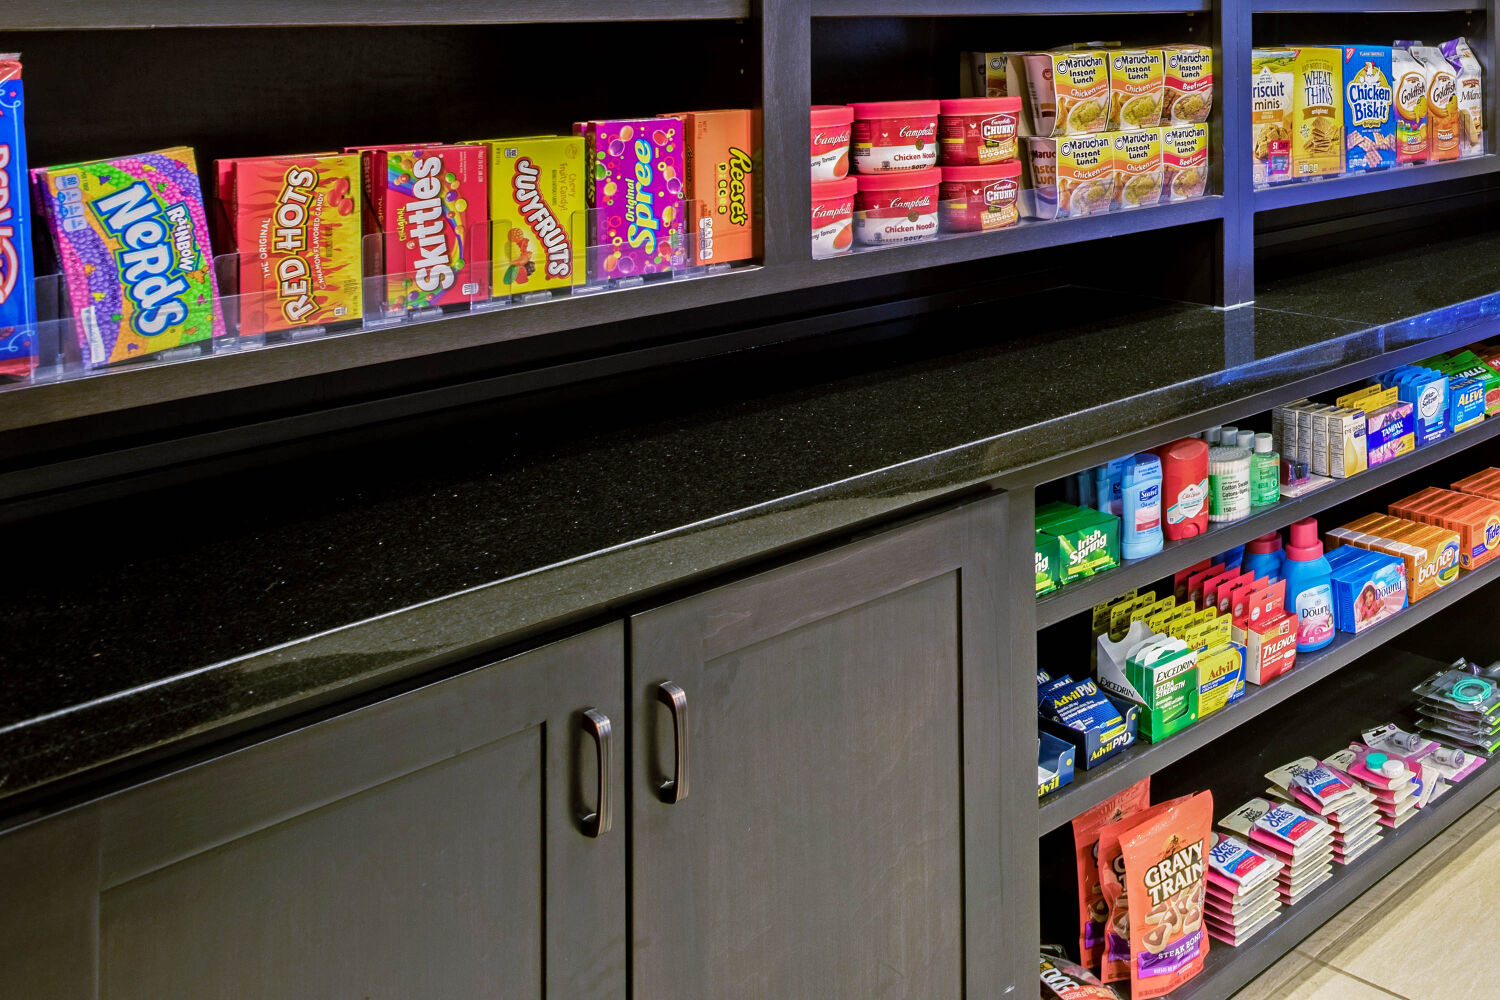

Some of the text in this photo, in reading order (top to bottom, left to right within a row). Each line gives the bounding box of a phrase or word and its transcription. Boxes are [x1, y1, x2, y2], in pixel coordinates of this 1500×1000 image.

[1068, 58, 1103, 69] Maruchan
[1121, 54, 1159, 64] Maruchan
[1176, 54, 1210, 63] Maruchan
[1069, 68, 1096, 77] Instant
[1125, 65, 1151, 73] Instant
[1179, 64, 1203, 72] Instant
[1181, 70, 1200, 78] Lunch
[1073, 76, 1094, 85] Lunch
[1128, 72, 1148, 80] Lunch
[1303, 71, 1333, 87] WHEAT
[1070, 87, 1096, 98] Chicken
[1125, 83, 1151, 92] Chicken
[1182, 81, 1198, 90] Beef
[1252, 84, 1285, 98] riscuit
[1433, 81, 1456, 104] Goldfish
[1349, 85, 1391, 103] Chicken
[1401, 84, 1426, 105] Goldfish
[1254, 99, 1281, 110] minis
[1354, 103, 1387, 121] Biskit
[983, 123, 1015, 135] CHUNKY
[1172, 129, 1205, 139] Maruchan
[1070, 138, 1109, 150] Maruchan
[1123, 133, 1158, 144] Maruchan
[1174, 139, 1197, 147] Instant
[1073, 150, 1101, 159] Instant
[1125, 144, 1150, 153] Instant
[1128, 151, 1148, 159] Lunch
[1177, 146, 1195, 154] Lunch
[1076, 157, 1098, 166] Lunch
[1126, 162, 1150, 171] Chicken
[1179, 158, 1193, 166] Beef
[1073, 168, 1100, 178] Chicken
[729, 147, 753, 226] Reese's
[625, 178, 637, 222] Original
[628, 138, 660, 255] Spree
[986, 188, 1016, 201] CHUNKY
[405, 156, 455, 292] Skittles
[514, 159, 570, 277] JUJYFRUITS
[884, 225, 915, 234] Chicken
[259, 217, 271, 260] ORIGINAL
[275, 168, 314, 321] RED HOTS
[1457, 387, 1484, 407] ALEVE
[1381, 420, 1404, 435] TAMPAX
[1140, 486, 1159, 500] Suave
[1077, 530, 1101, 549] Irish
[1069, 533, 1107, 565] Spring
[1417, 547, 1453, 586] bounce
[1375, 580, 1402, 602] Downy
[1301, 604, 1331, 619] Downy
[1262, 632, 1297, 658] TYLENOL
[1155, 657, 1196, 683] EXCEDRIN
[1208, 660, 1234, 682] Advil
[1100, 676, 1135, 699] EXCEDRIN
[1299, 767, 1322, 784] Wet
[1305, 770, 1331, 787] Ones
[1262, 806, 1285, 824] Wet
[1267, 809, 1294, 830] Ones
[1209, 839, 1231, 857] Wet
[1215, 843, 1241, 865] Ones
[1144, 839, 1204, 888] GRAVY
[1148, 860, 1204, 907] TRAIN
